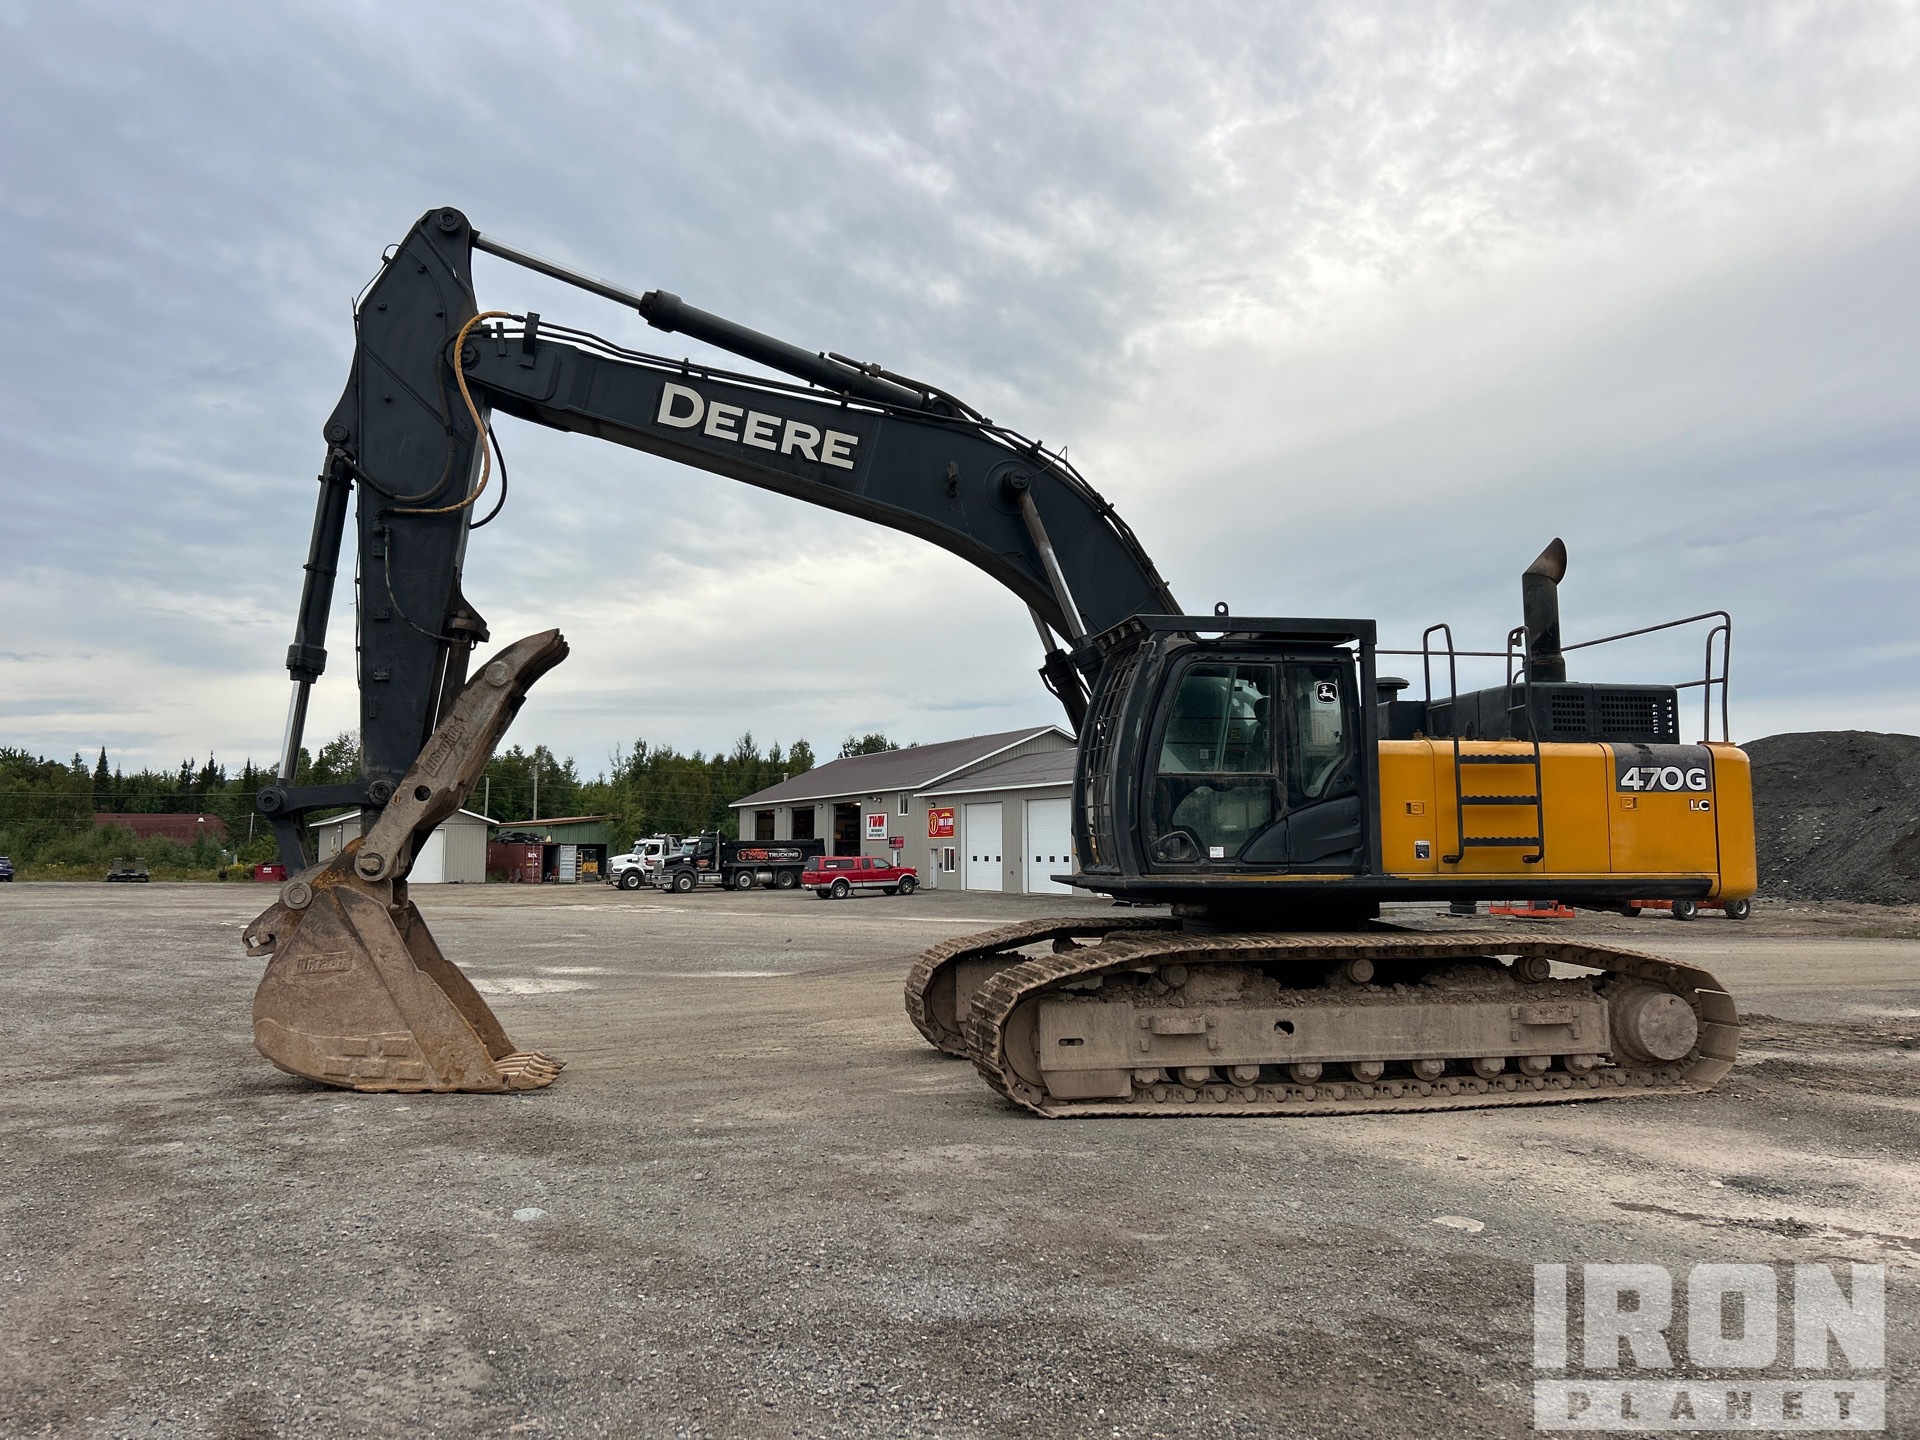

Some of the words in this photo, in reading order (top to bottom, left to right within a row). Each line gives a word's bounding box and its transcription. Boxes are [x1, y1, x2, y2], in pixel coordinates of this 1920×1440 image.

[657, 382, 859, 470] DEERE
[1620, 766, 1707, 791] 470G
[1690, 799, 1710, 811] LC
[741, 850, 769, 860] TWIN
